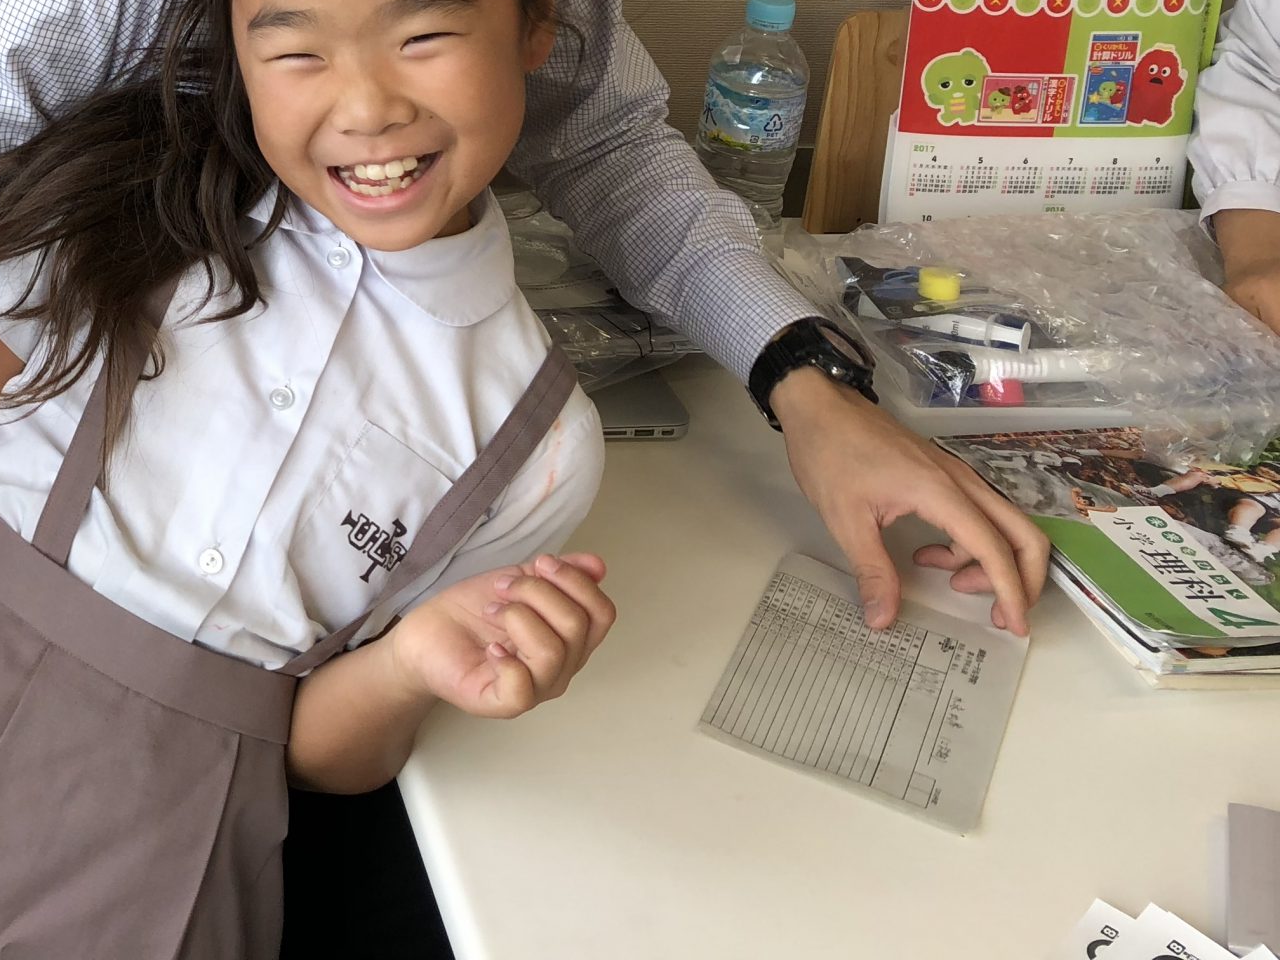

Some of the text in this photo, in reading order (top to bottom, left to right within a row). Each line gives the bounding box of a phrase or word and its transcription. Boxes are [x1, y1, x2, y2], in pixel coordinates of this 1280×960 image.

[1091, 50, 1134, 61] 計算ドリル
[913, 144, 936, 153] 2017
[931, 155, 938, 163] 4
[977, 156, 984, 164] 5
[1022, 157, 1029, 165] 6
[1067, 157, 1074, 165] 7
[1112, 157, 1119, 165] 8
[1155, 156, 1161, 165] 9
